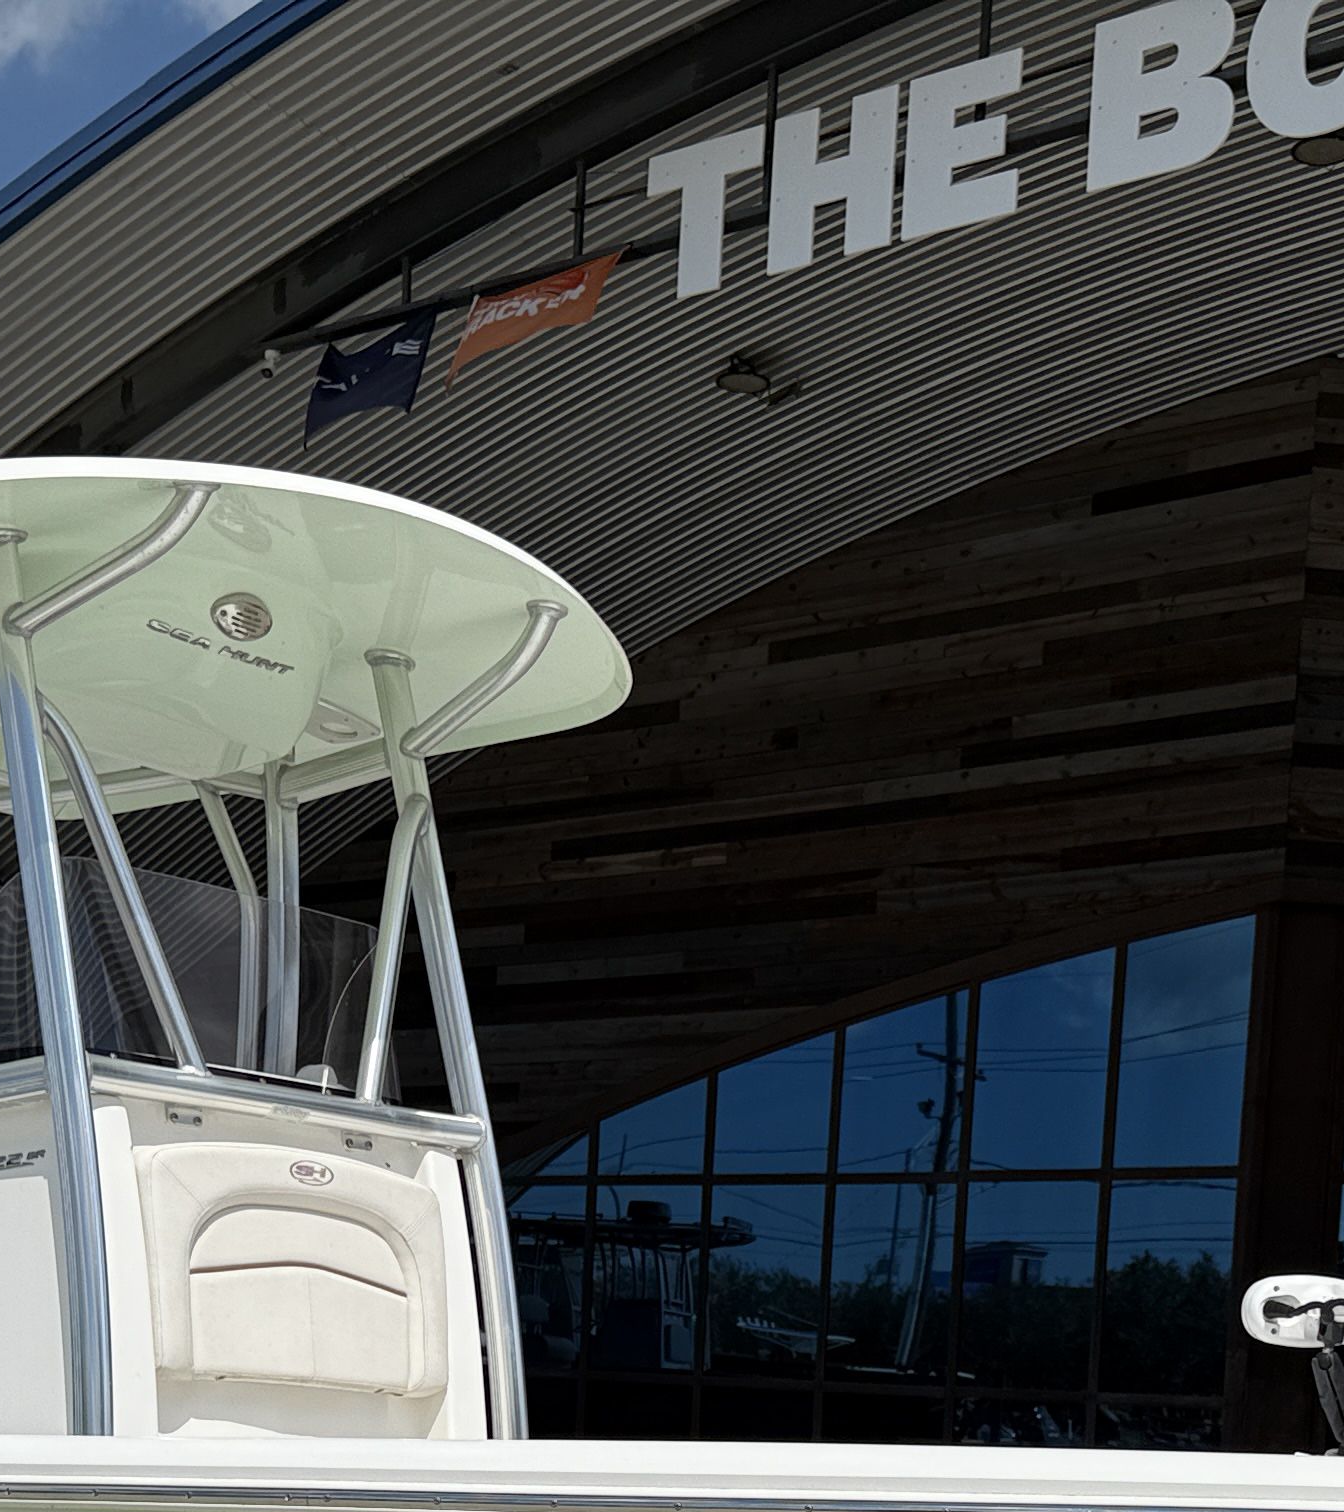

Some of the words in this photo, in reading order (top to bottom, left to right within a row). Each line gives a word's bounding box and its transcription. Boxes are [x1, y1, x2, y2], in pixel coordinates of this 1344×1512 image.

[647, 47, 1024, 299] THE
[146, 619, 211, 650] SEA
[218, 645, 295, 674] HUNT
